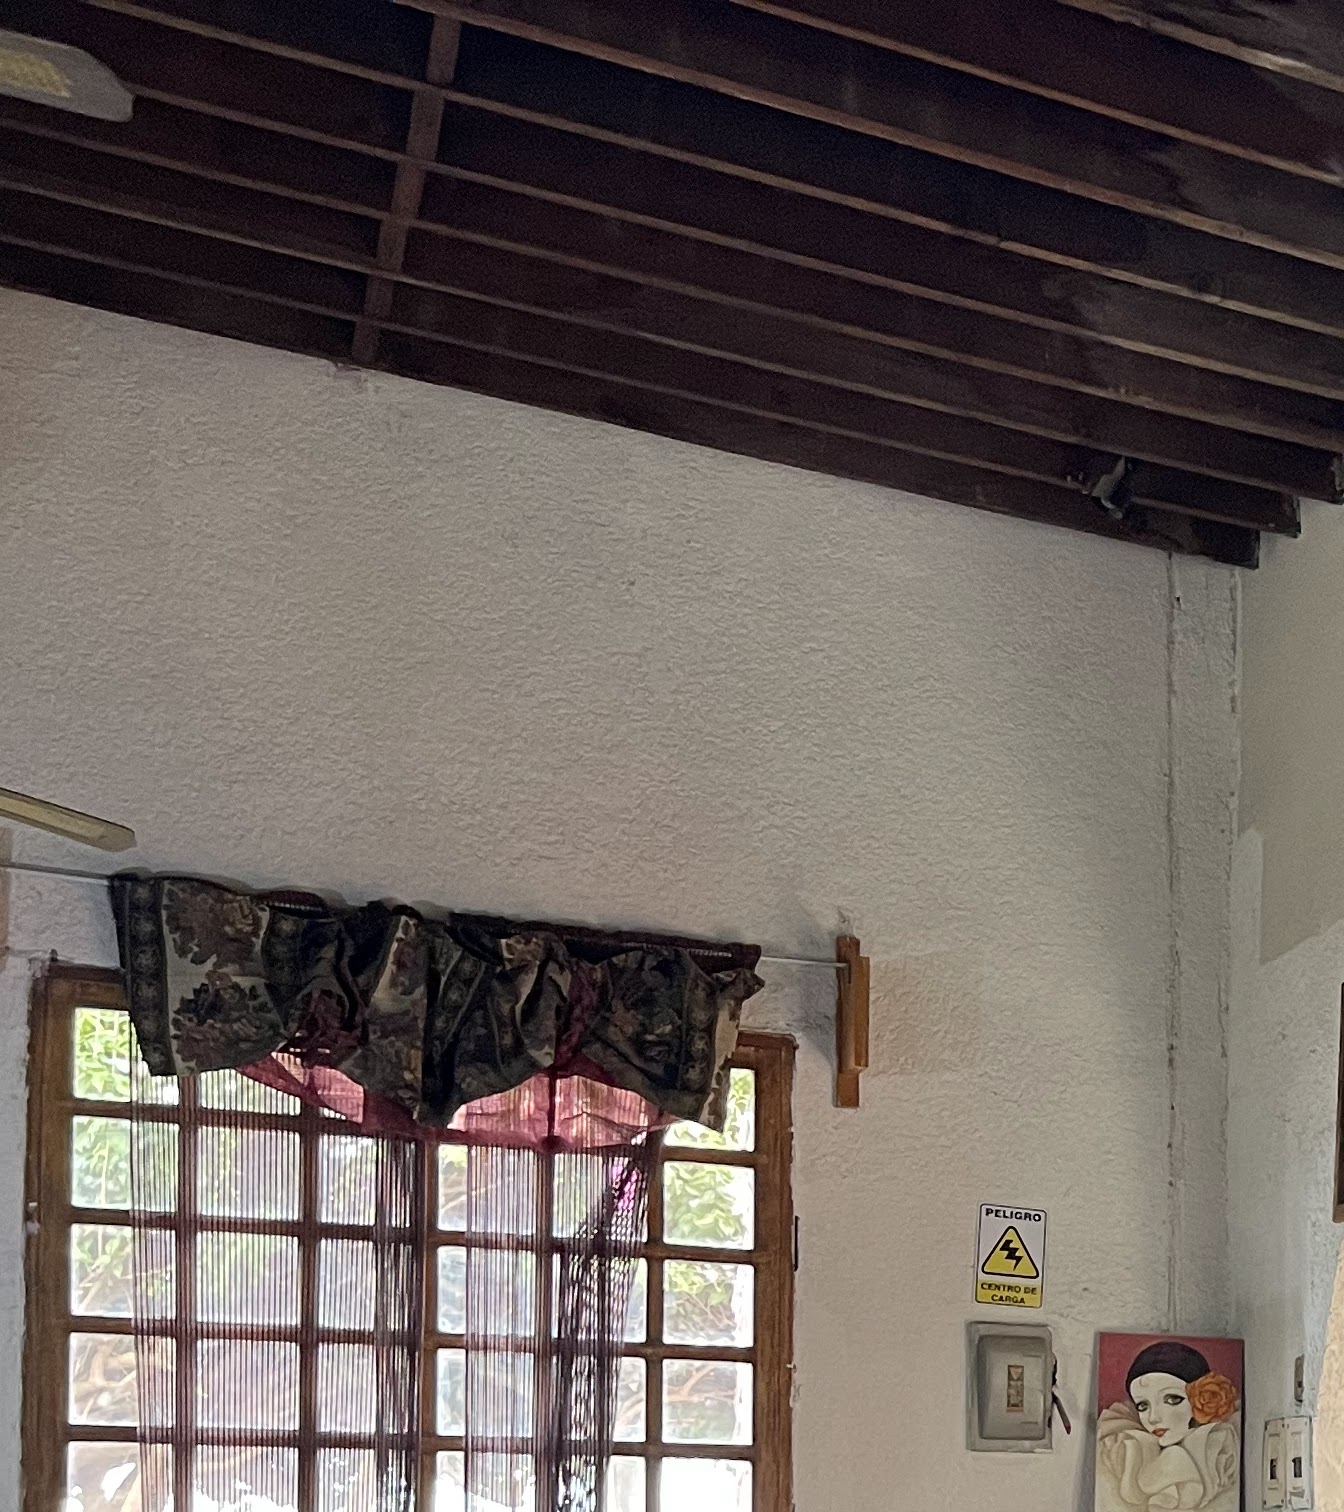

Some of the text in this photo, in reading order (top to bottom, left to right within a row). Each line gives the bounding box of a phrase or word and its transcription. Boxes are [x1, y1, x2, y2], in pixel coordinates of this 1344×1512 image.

[985, 1207, 1042, 1222] PELIGRO
[980, 1282, 1037, 1295] CENTRO DE
[990, 1294, 1026, 1305] CARGA
